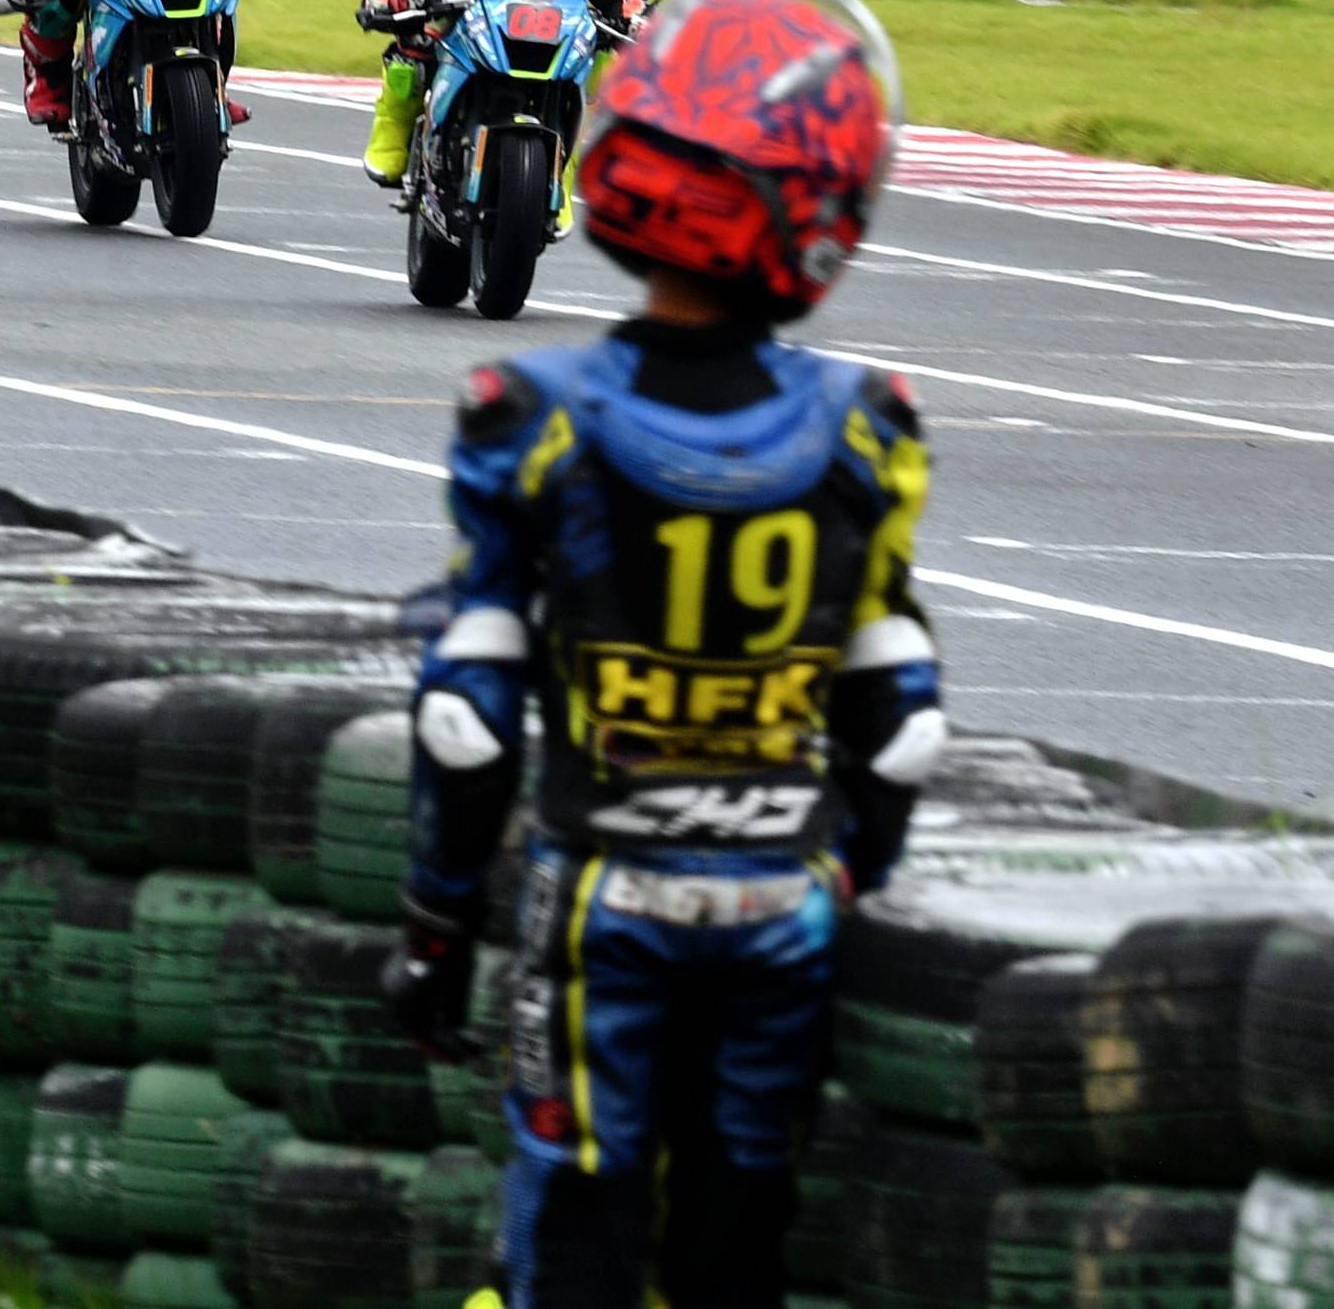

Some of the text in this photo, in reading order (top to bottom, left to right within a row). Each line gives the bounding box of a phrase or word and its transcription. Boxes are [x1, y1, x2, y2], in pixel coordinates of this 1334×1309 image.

[508, 4, 561, 38] 08
[656, 509, 815, 654] 19
[597, 657, 818, 725] HFK
